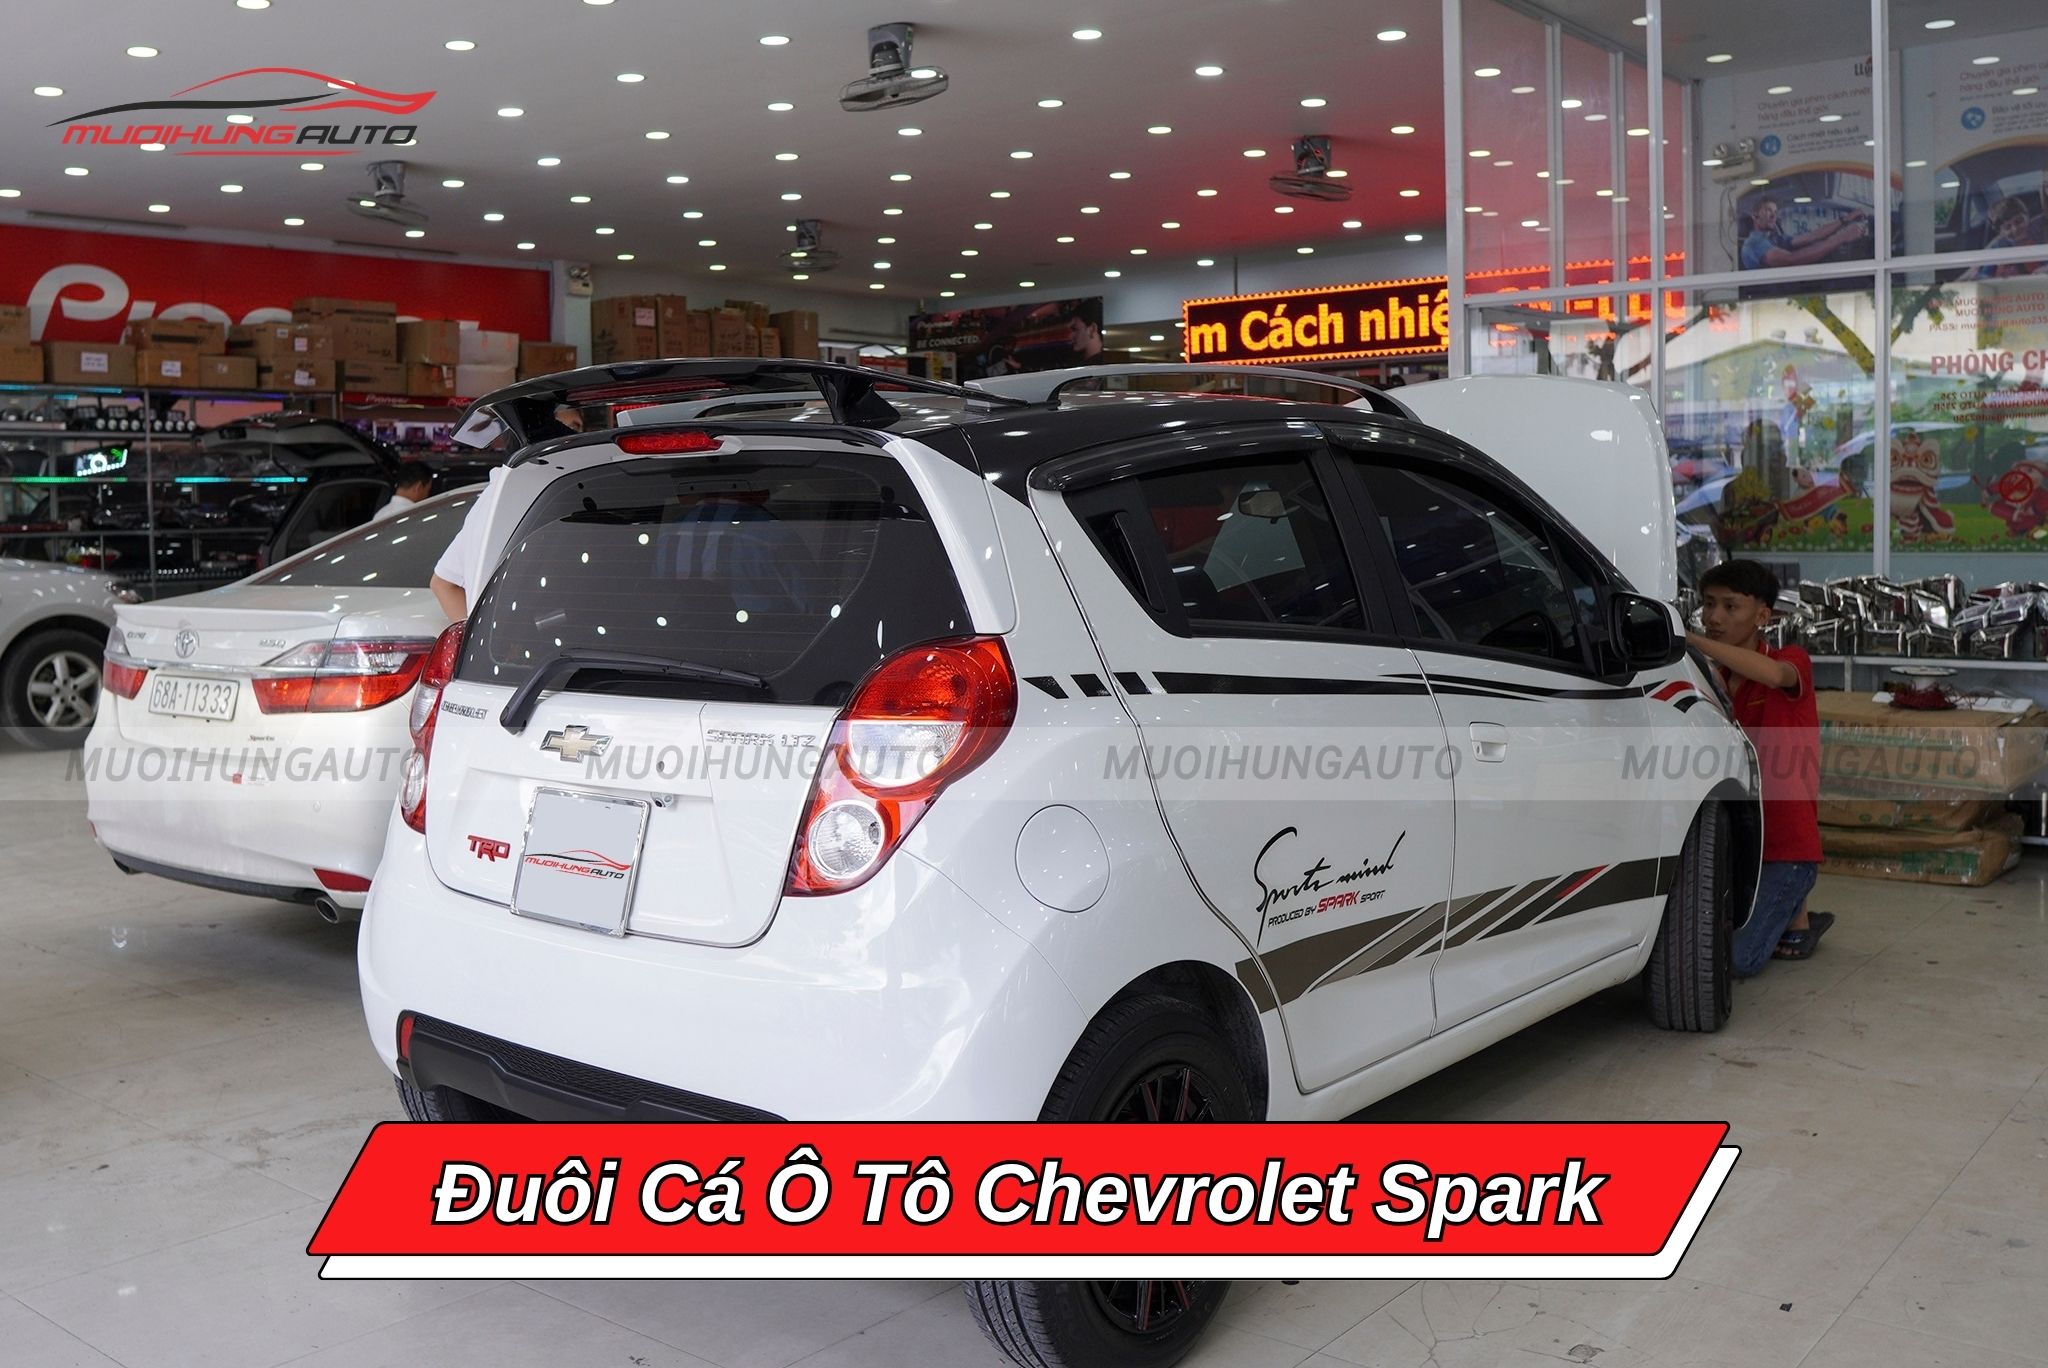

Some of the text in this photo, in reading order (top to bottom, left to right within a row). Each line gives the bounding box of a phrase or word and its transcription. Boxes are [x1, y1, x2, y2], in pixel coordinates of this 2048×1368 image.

[1240, 303, 1344, 352] Cách
[1931, 348, 2014, 376] PHÒNG
[705, 728, 817, 748] SPARK LTZ
[467, 834, 511, 862] TRD
[1267, 889, 1386, 928] PRODUCED BY SPARK SPORT
